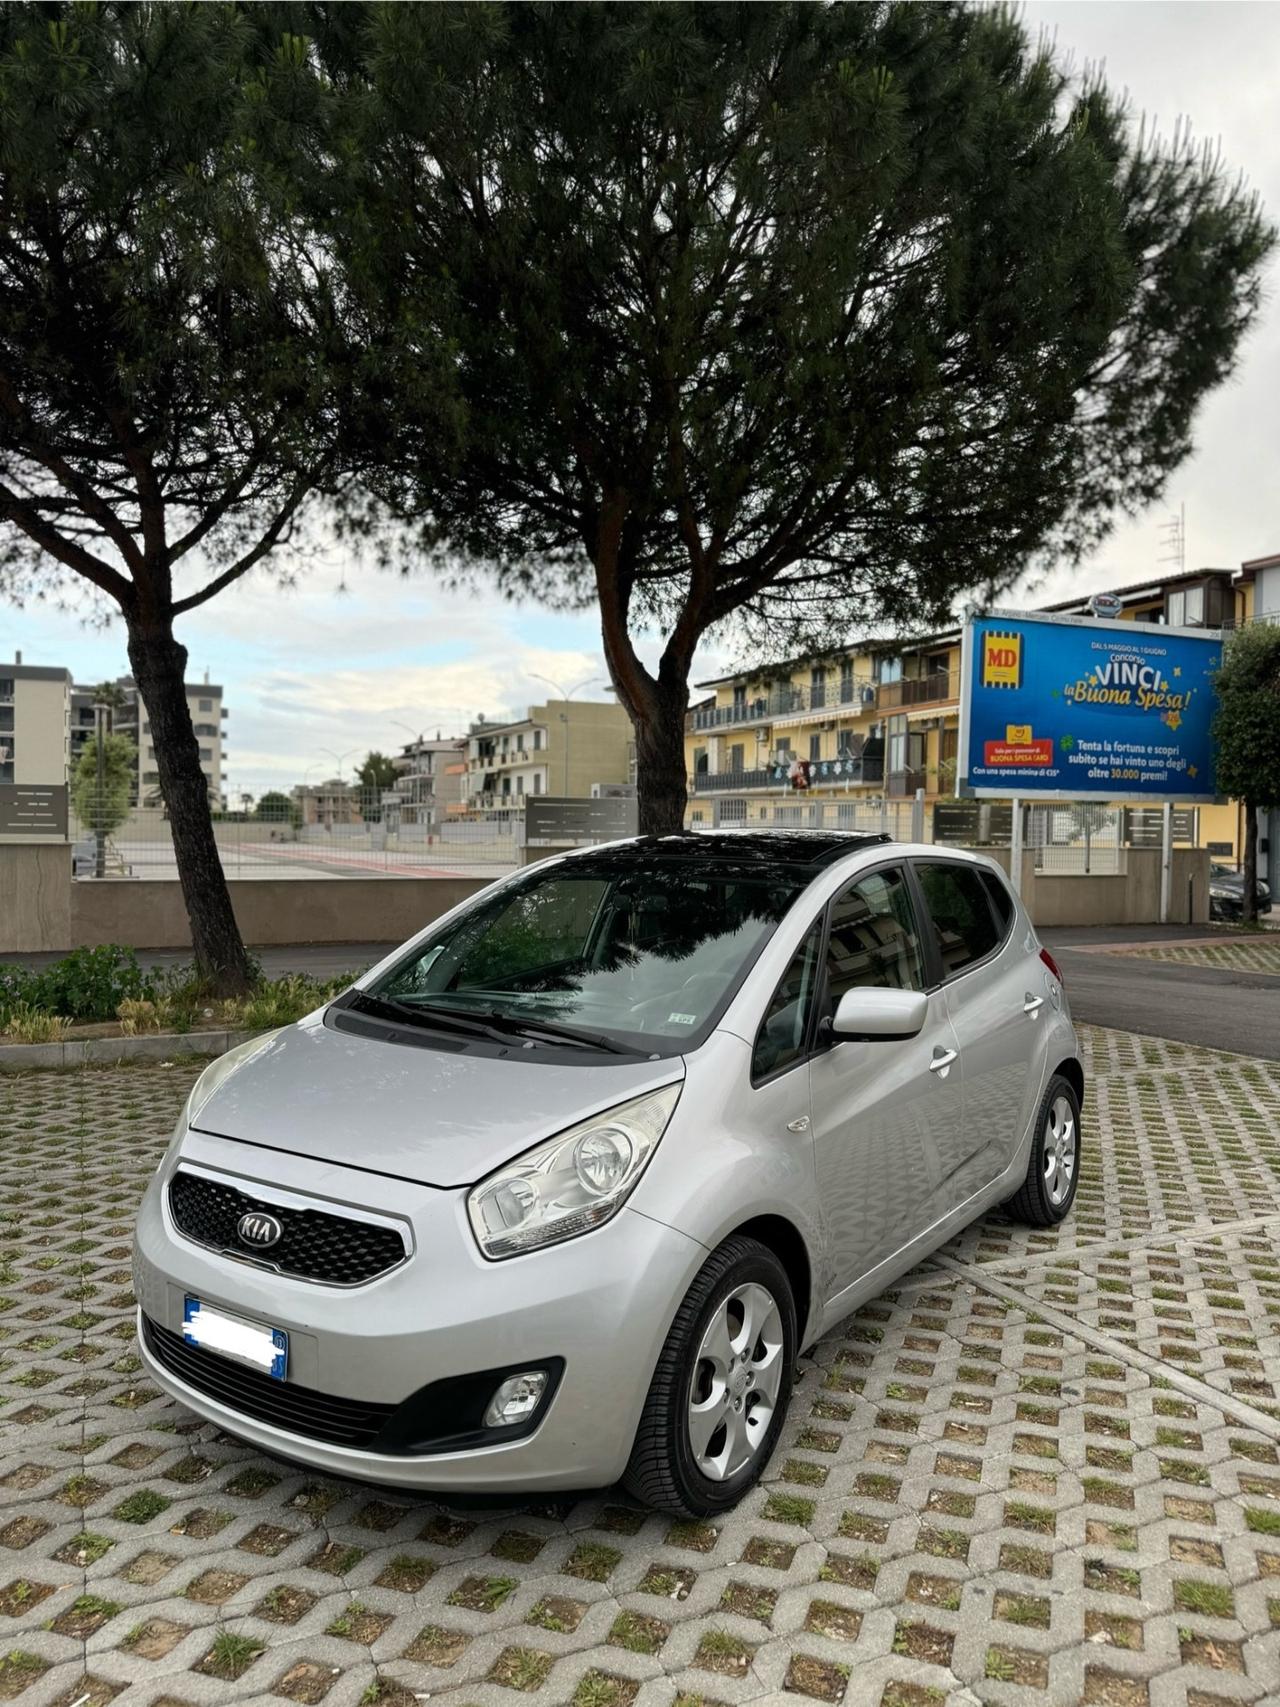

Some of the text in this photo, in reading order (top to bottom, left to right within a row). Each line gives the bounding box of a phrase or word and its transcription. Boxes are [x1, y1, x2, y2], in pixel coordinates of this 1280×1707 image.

[988, 648, 1017, 668] MD
[1108, 644, 1131, 652] MAGGIO
[1144, 648, 1167, 656] GIUGNO
[1095, 662, 1161, 692] VINCI
[1064, 680, 1191, 711] la Buona Spesa!
[1077, 740, 1102, 751] Tenta
[1104, 740, 1112, 752] la
[1114, 741, 1145, 754] fortuna
[1154, 745, 1180, 758] scopri
[1068, 753, 1097, 764] subito
[1098, 757, 1108, 765] se
[1110, 754, 1123, 765] hai
[1125, 756, 1147, 766] vinto
[1166, 758, 1186, 771] degli
[1018, 768, 1038, 776] minima
[1088, 767, 1168, 782] oltre 30.000 premi!
[241, 1216, 270, 1242] KIA
